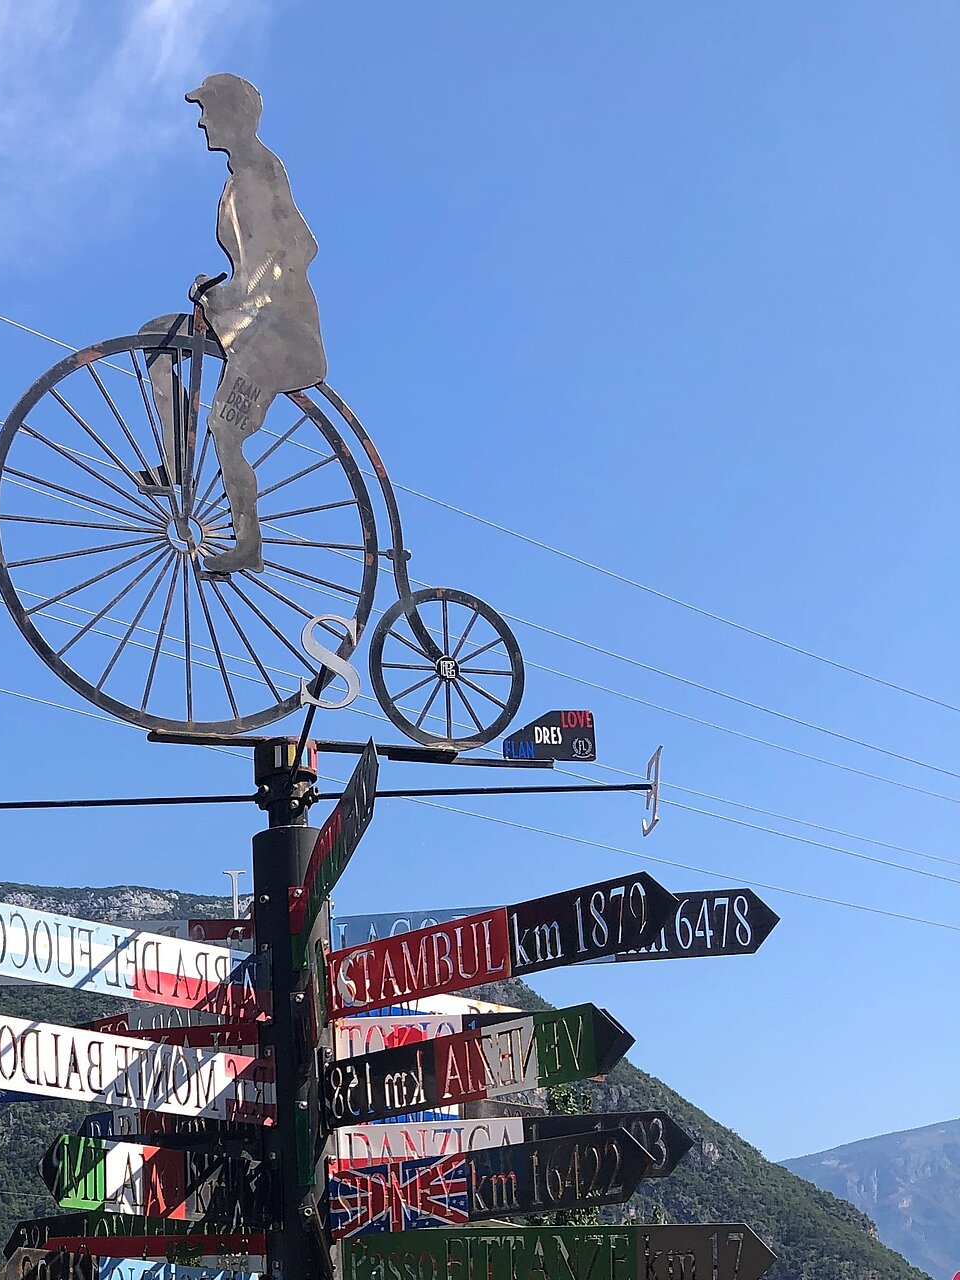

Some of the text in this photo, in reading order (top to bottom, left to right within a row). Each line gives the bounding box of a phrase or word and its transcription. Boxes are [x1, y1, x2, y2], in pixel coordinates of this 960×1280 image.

[219, 404, 250, 431] LOVE
[559, 709, 593, 729] LOVE
[534, 726, 563, 745] DRES
[504, 740, 536, 759] FLAN
[674, 895, 753, 952] 6478
[328, 916, 507, 1012] ISTAMBUL
[511, 912, 563, 969] km
[471, 1157, 520, 1213] km
